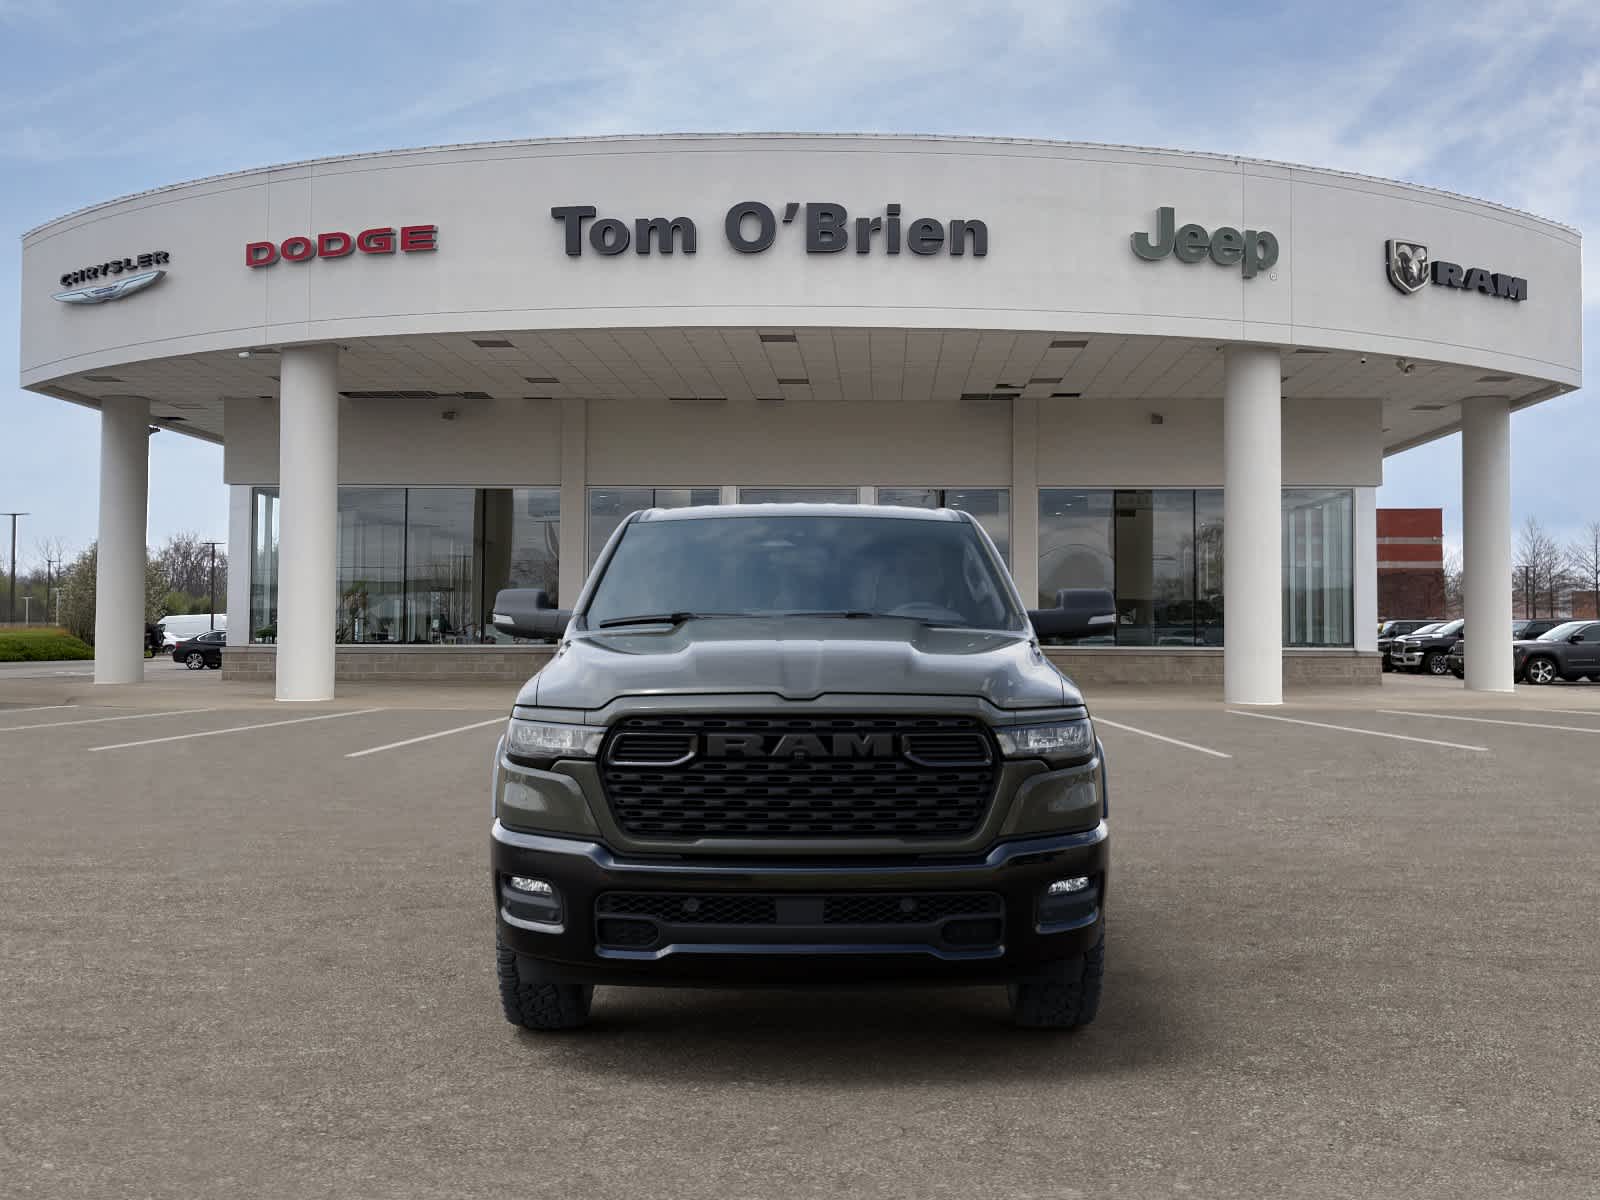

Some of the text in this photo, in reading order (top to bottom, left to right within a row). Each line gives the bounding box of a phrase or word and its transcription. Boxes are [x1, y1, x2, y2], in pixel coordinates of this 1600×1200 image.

[245, 224, 438, 270] DODGE
[551, 205, 697, 257] Tom
[1130, 206, 1279, 279] Jeep
[60, 249, 170, 288] CHRYSLER
[1431, 261, 1528, 301] RAM
[706, 732, 895, 758] RAM
